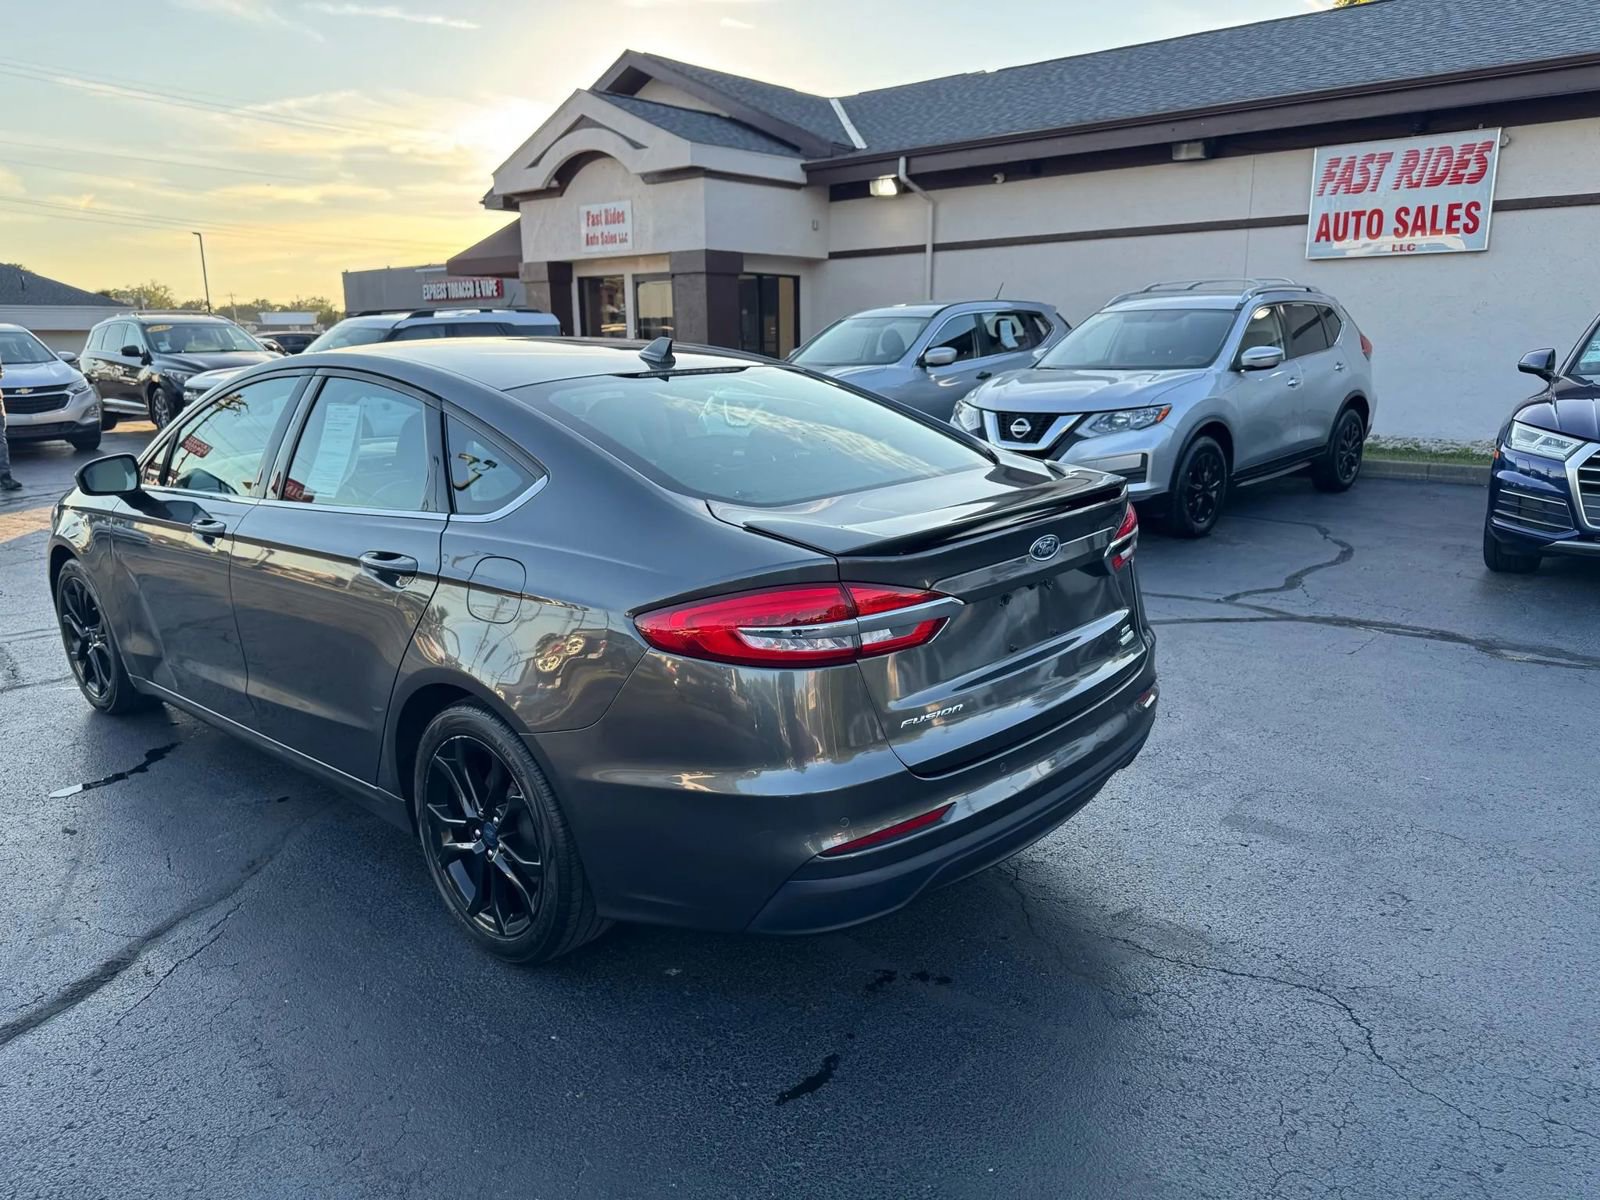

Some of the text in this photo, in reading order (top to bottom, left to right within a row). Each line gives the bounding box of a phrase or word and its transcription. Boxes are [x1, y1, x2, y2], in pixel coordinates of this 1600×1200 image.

[1316, 141, 1495, 197] FAST RIDES
[586, 207, 626, 228] Fast Rides
[1315, 201, 1482, 243] AUTO SALES
[586, 232, 600, 247] Auto
[600, 231, 617, 246] Sales
[1391, 243, 1416, 252] LLC
[422, 279, 498, 300] EXPRESS TOBACCO & VAPE
[1035, 537, 1057, 557] Ford
